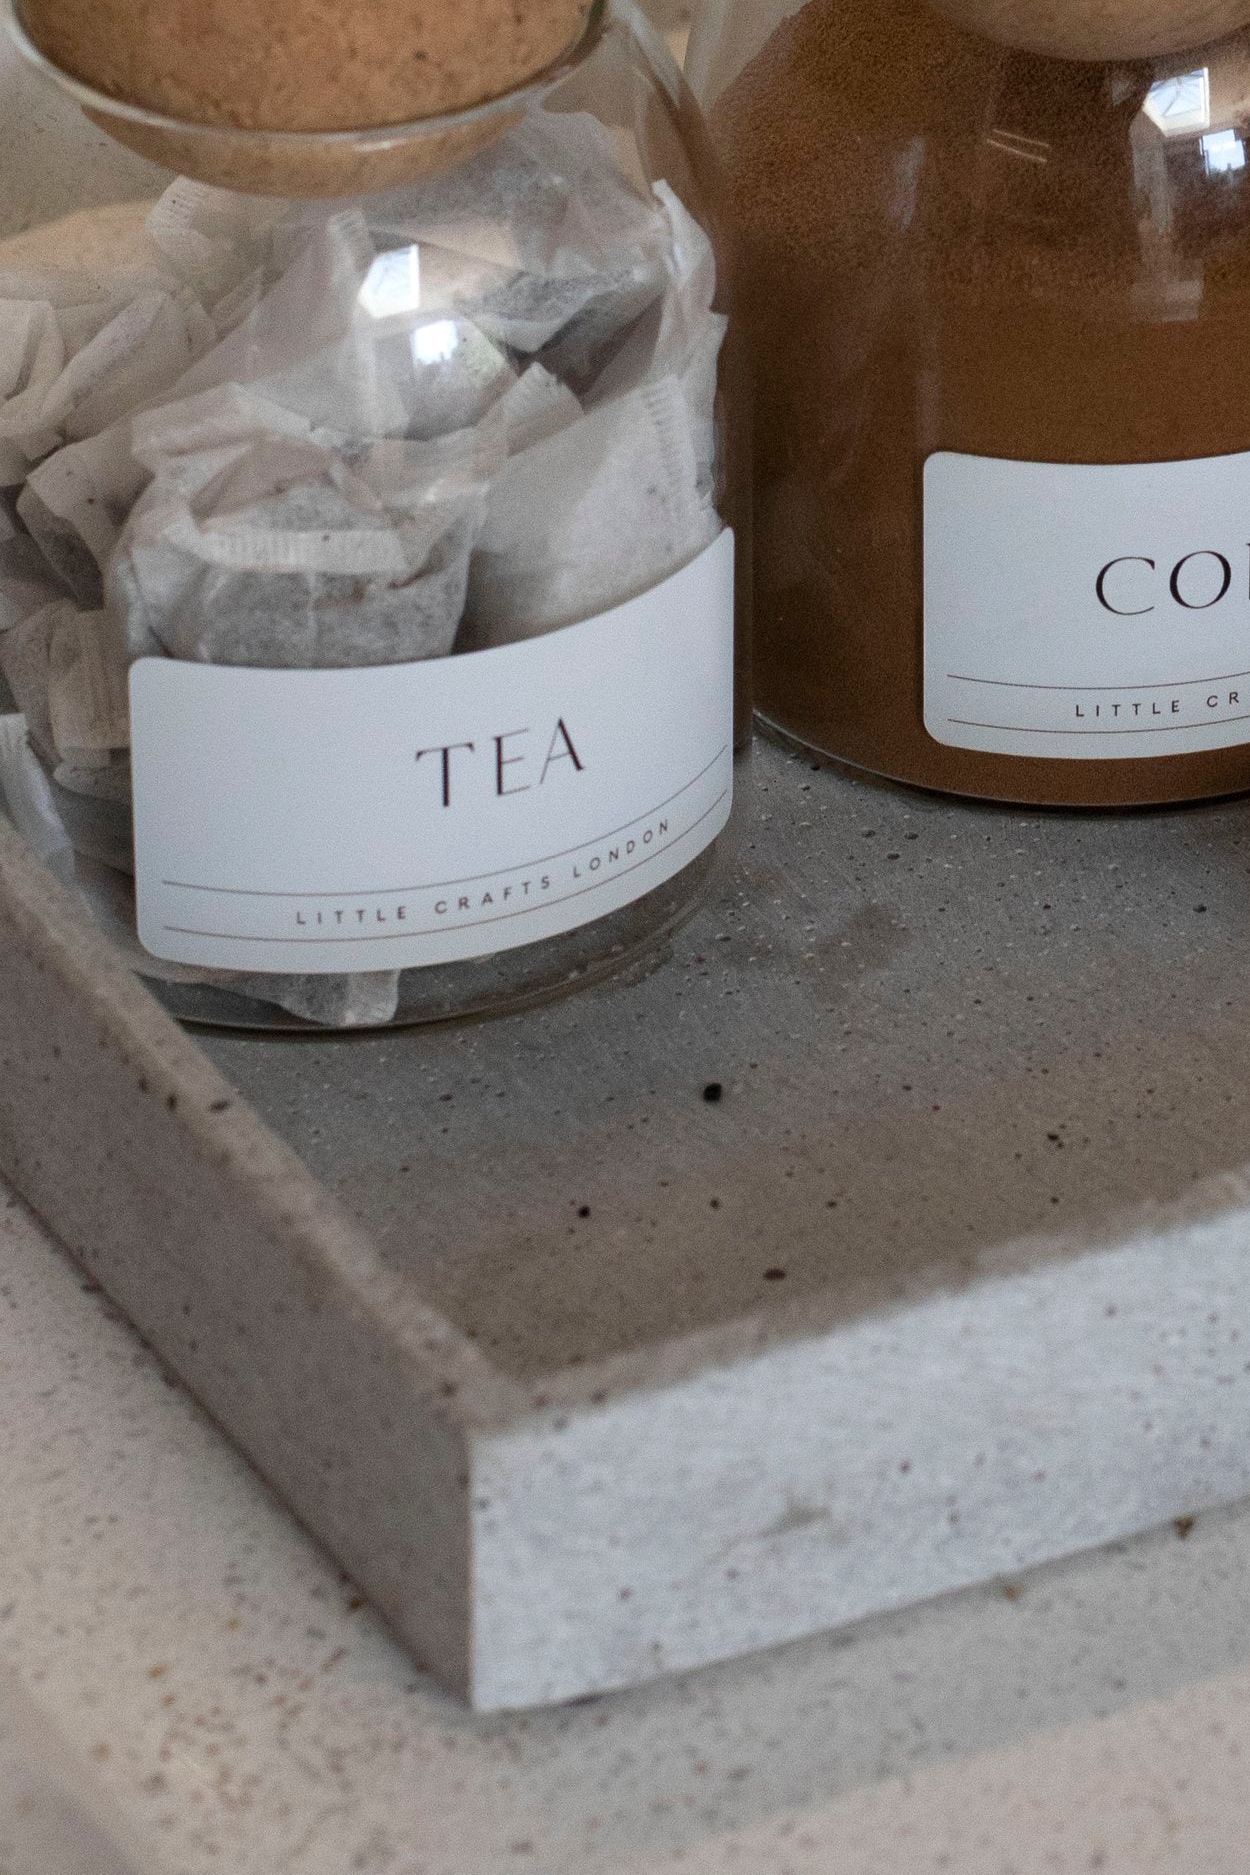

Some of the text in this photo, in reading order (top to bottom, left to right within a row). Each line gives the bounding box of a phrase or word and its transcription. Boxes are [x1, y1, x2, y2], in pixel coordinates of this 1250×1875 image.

[1075, 699, 1181, 718] LITTLE
[413, 715, 587, 810] TEA
[295, 818, 670, 927] LITTLE CRAFTS LONDON
